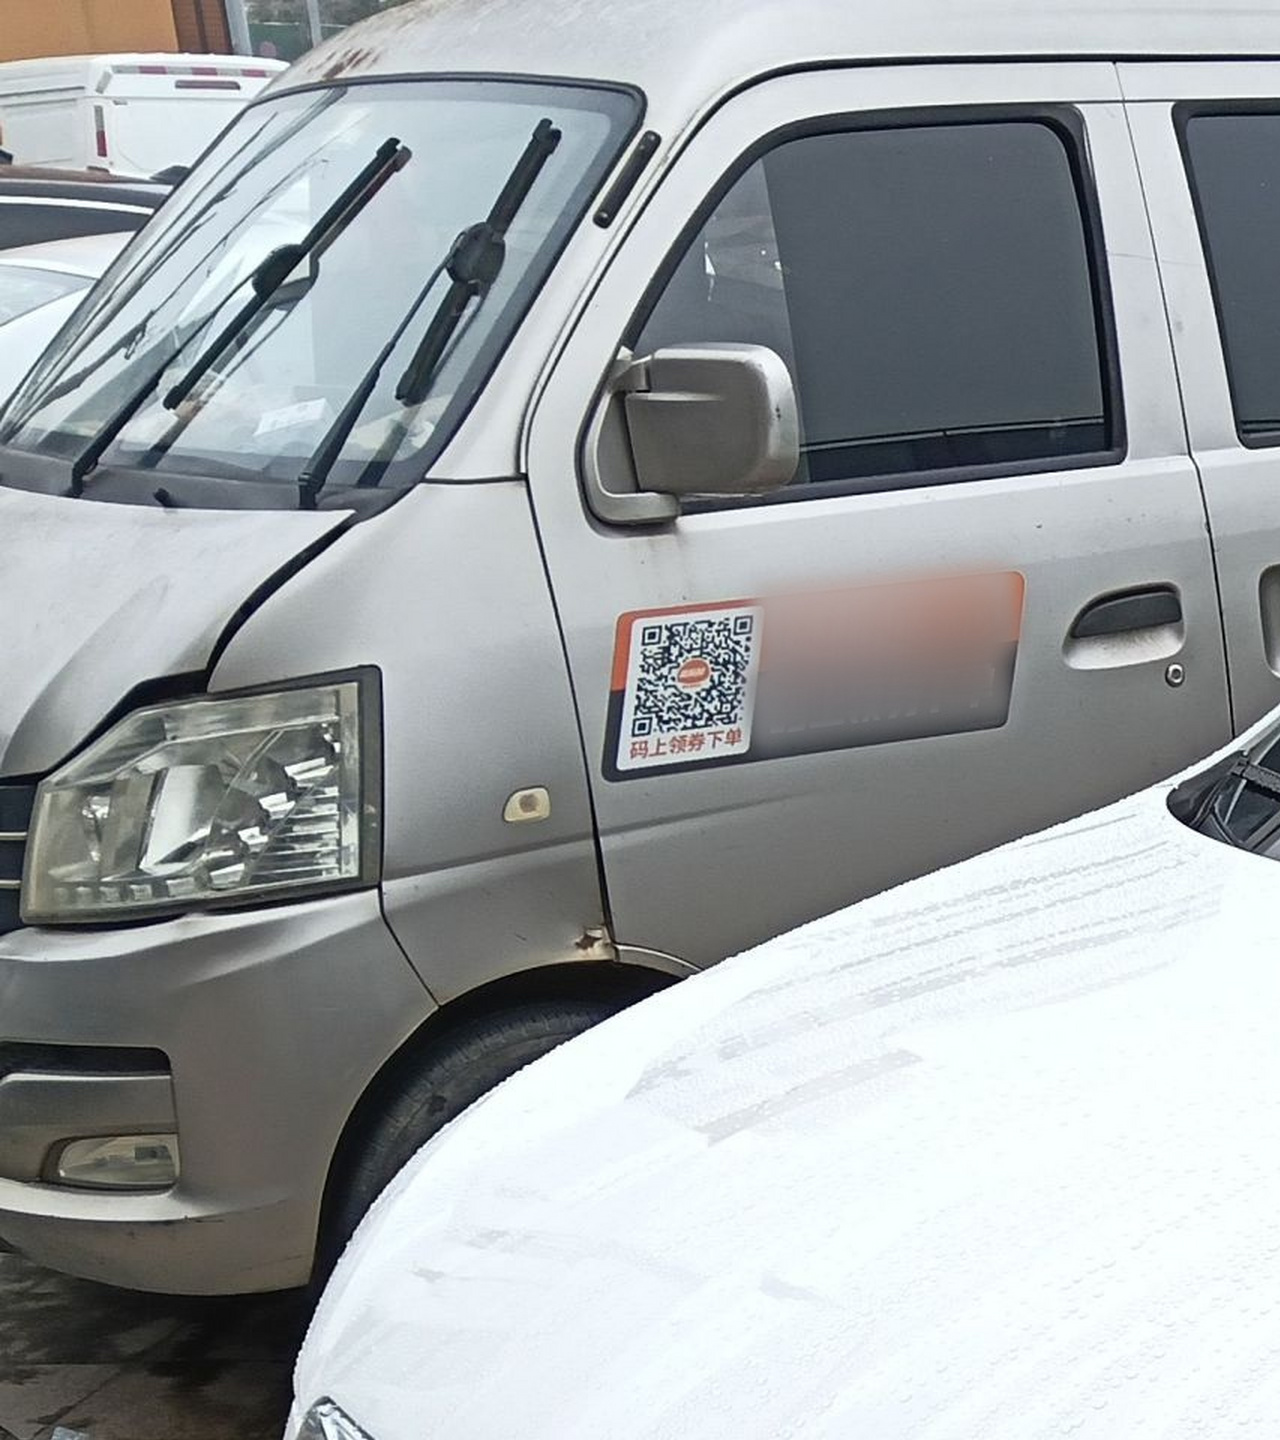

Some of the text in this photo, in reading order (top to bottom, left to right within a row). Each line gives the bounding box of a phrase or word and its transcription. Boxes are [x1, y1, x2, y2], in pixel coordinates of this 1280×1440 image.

[630, 728, 742, 759] 码上领券下单
